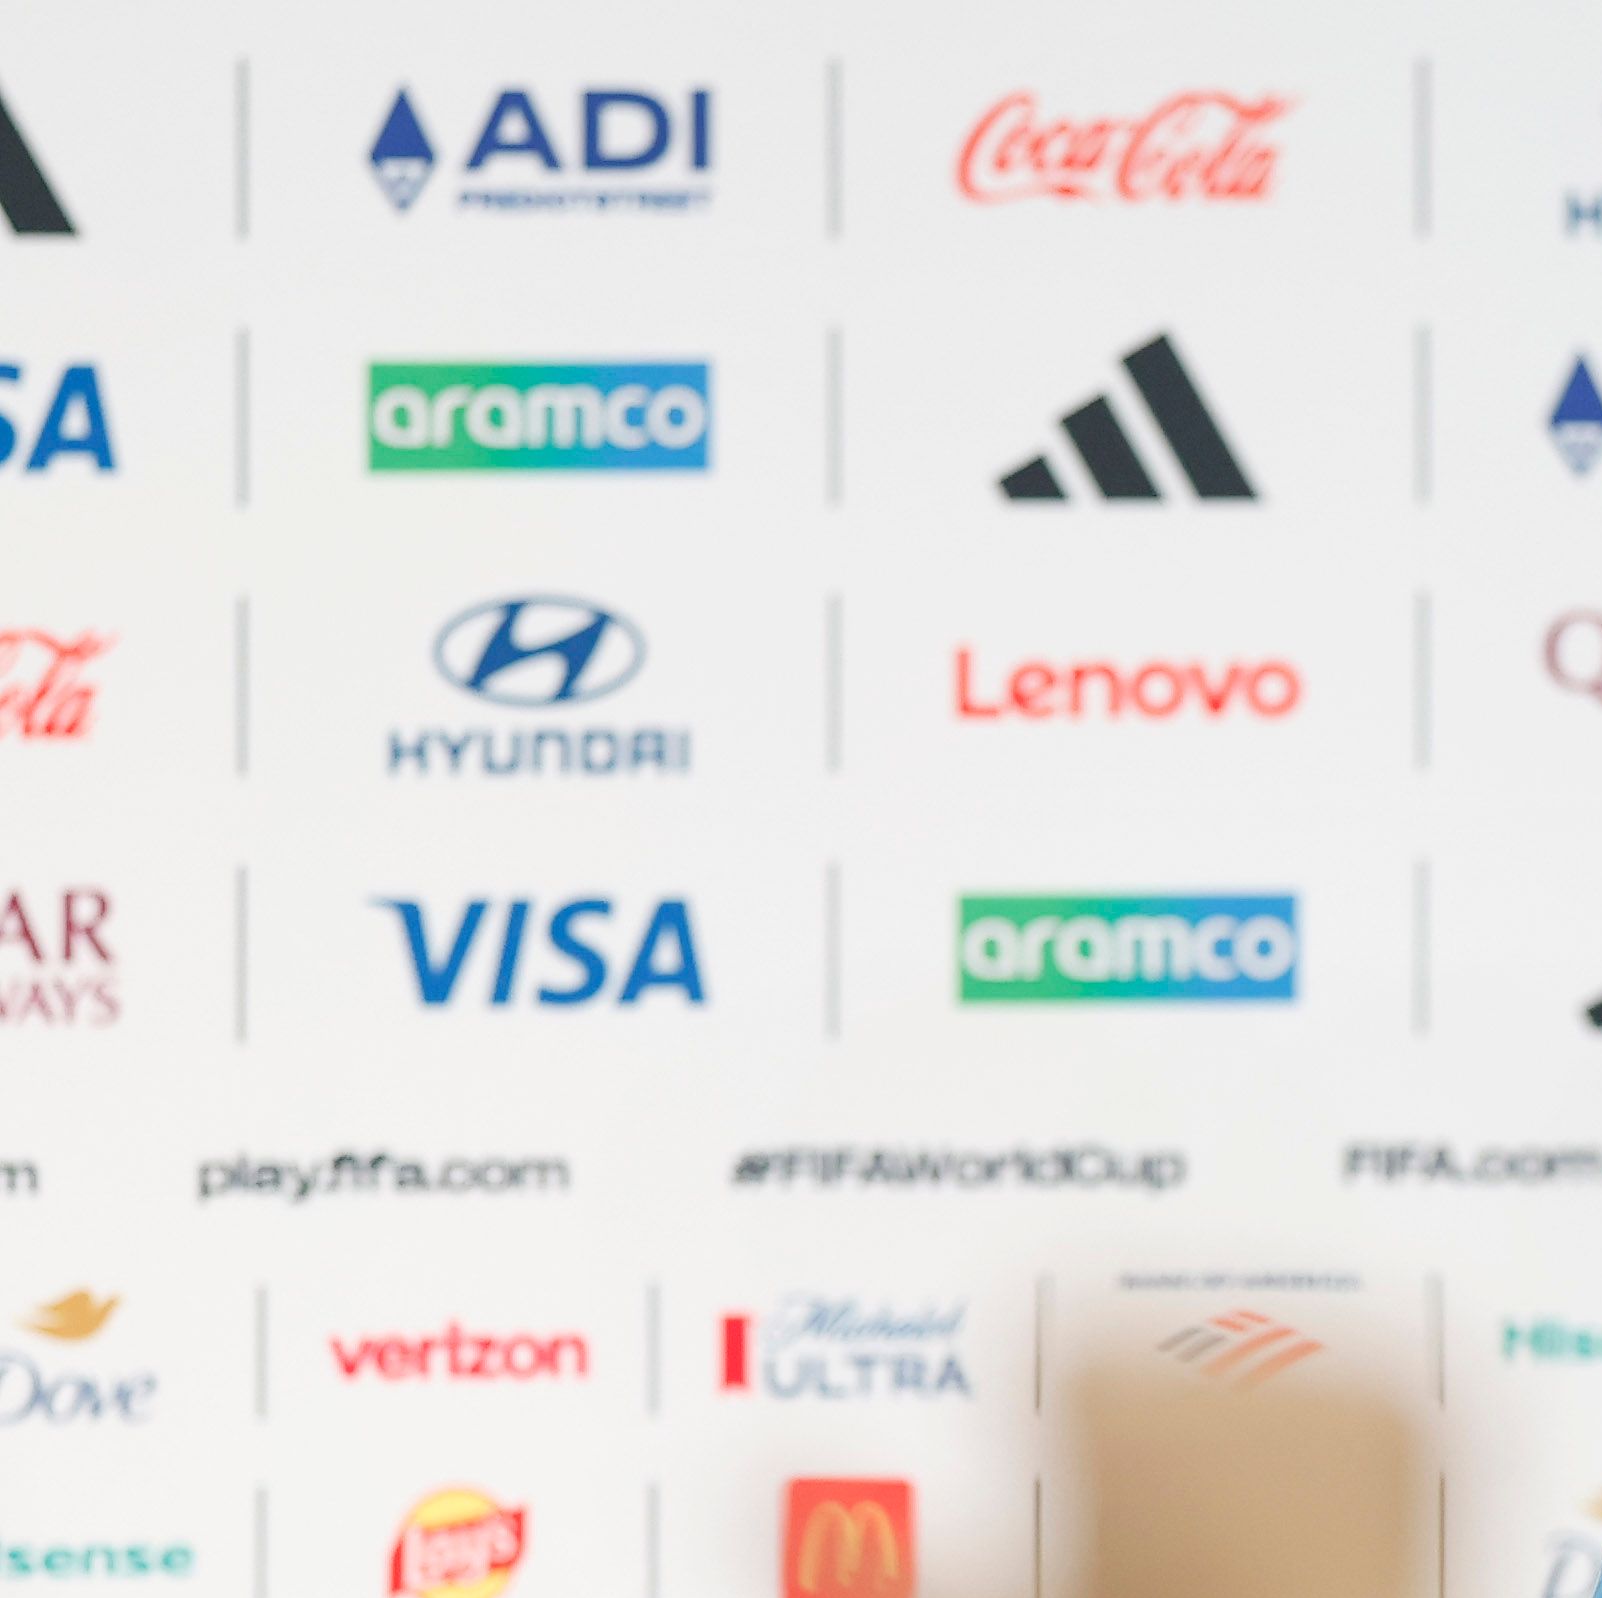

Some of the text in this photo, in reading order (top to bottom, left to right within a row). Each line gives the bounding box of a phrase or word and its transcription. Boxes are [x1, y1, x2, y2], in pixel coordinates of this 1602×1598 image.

[465, 88, 711, 172] ADI
[374, 385, 706, 448] aramco
[954, 647, 1302, 720] Lenovo
[388, 728, 690, 776] HYUNDAI
[388, 898, 706, 1007] VISA
[964, 916, 1294, 980] aramco
[330, 1323, 589, 1380] verizon
[764, 1353, 974, 1399] ULTRA
[0, 1545, 194, 1577] sense
